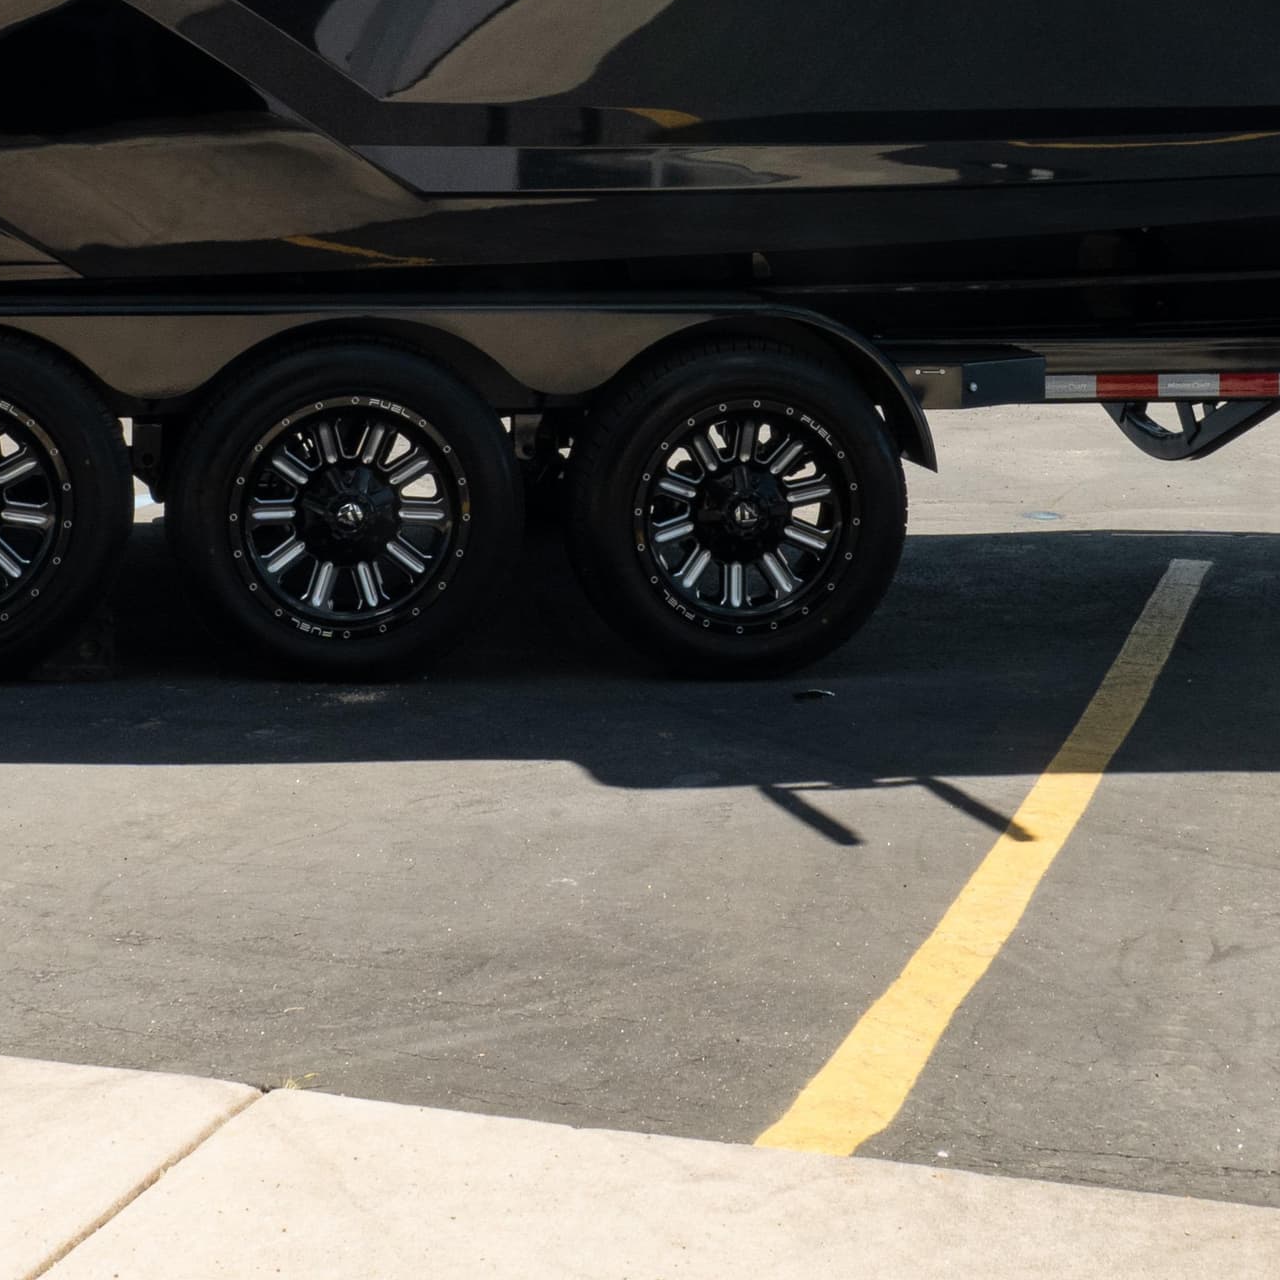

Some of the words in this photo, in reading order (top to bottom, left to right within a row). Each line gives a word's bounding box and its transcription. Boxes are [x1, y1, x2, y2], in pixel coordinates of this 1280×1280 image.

[368, 398, 410, 418] FUEL
[800, 414, 833, 447] FUEL
[663, 588, 696, 622] FUEL
[291, 616, 333, 637] FUEL
